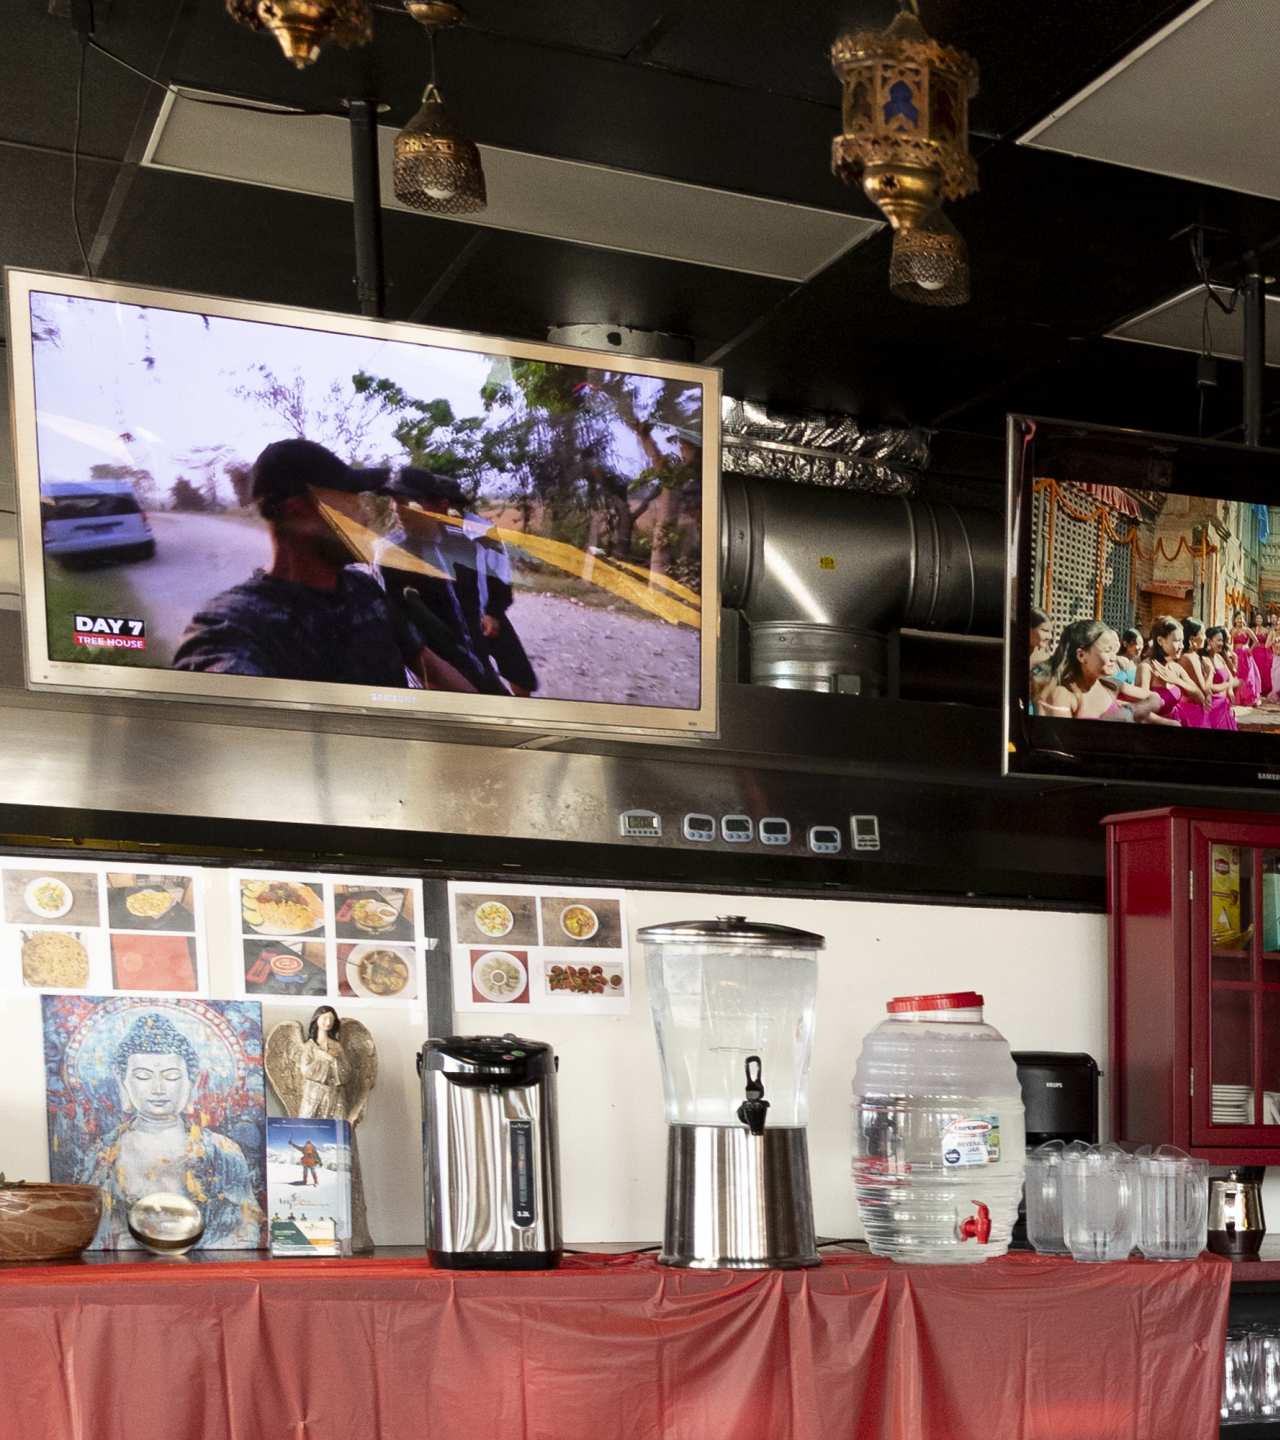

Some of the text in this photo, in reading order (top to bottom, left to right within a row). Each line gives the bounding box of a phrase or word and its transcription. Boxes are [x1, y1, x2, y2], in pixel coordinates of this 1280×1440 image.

[76, 616, 143, 636] DAY 7
[79, 636, 143, 648] TREE HOUSE
